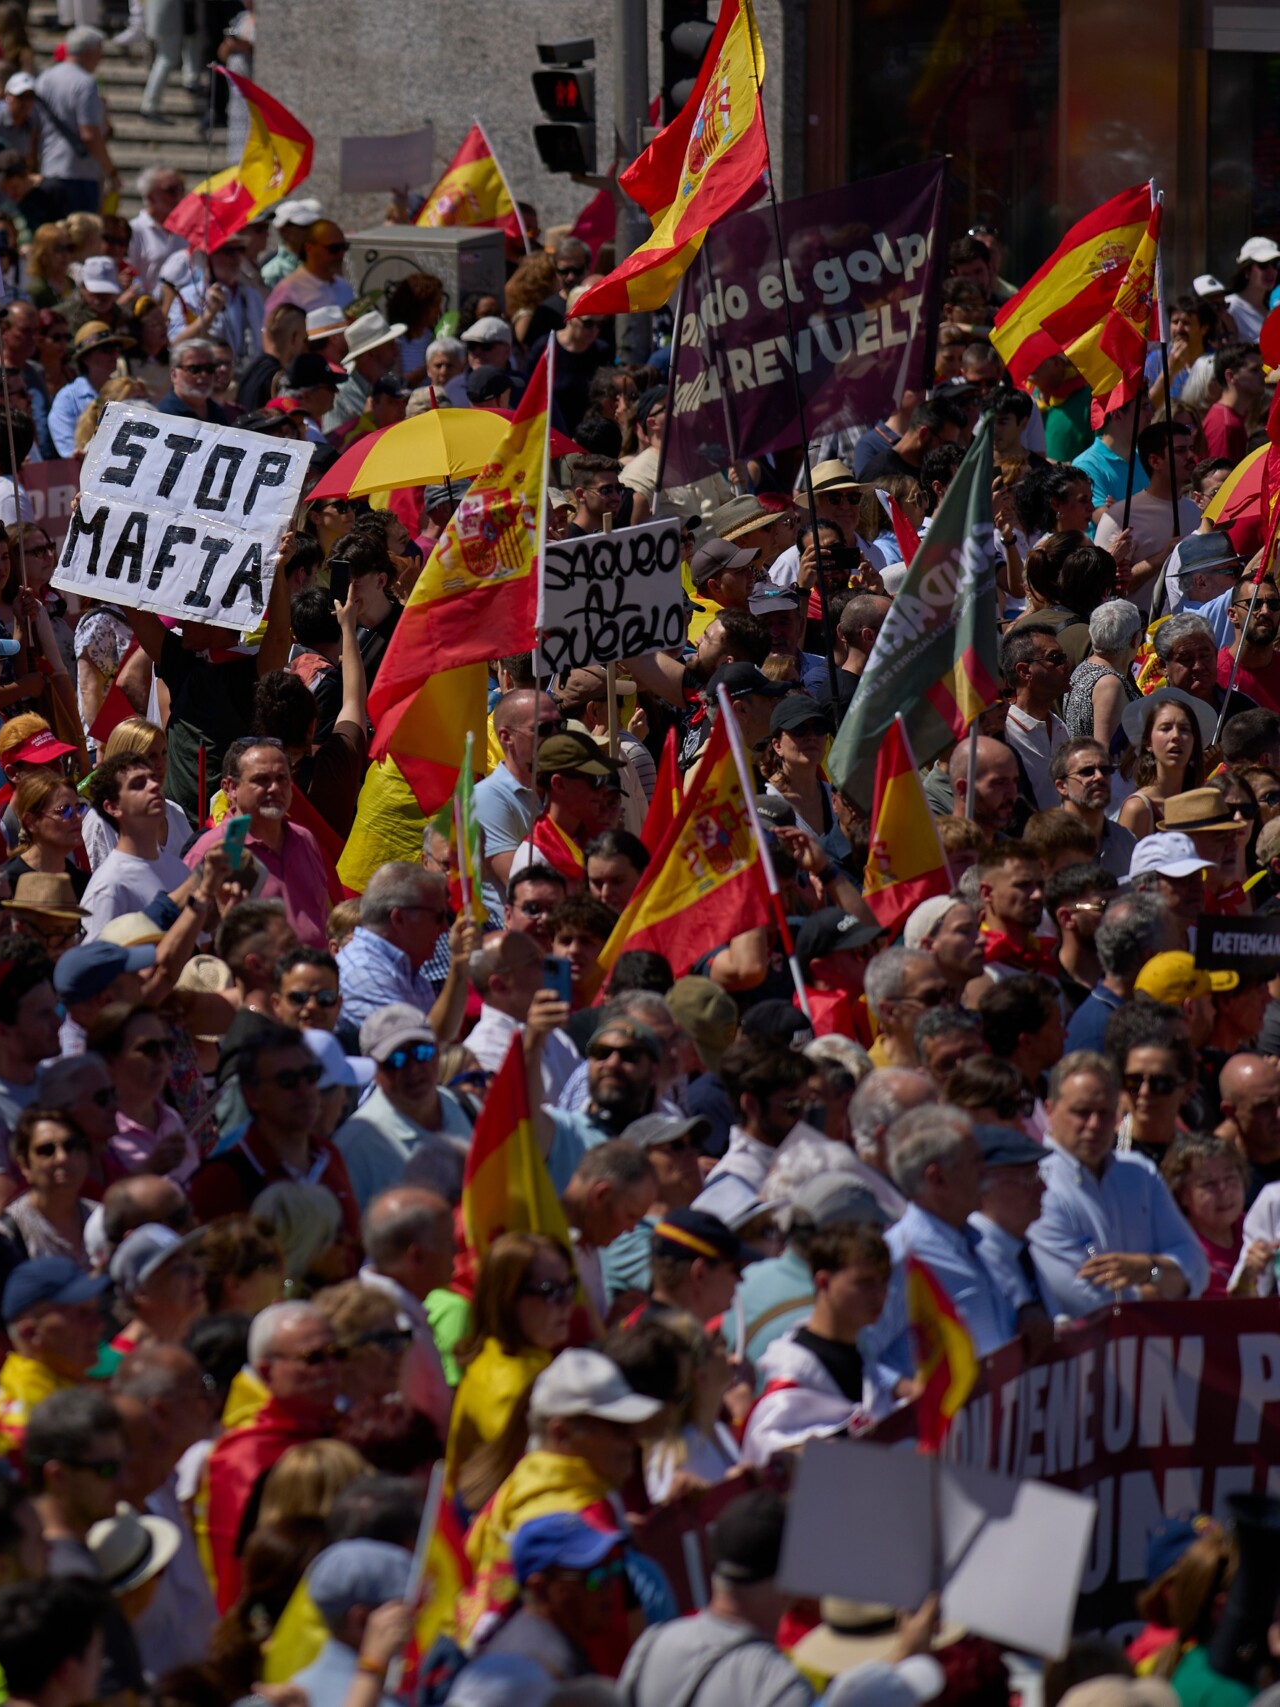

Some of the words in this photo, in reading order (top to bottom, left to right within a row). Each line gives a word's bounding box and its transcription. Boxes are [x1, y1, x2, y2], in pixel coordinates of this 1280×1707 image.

[757, 258, 805, 310] el
[99, 420, 292, 516] STOP
[61, 505, 265, 616] MAFIA
[564, 576, 641, 626] AL
[1101, 1334, 1205, 1455] UN
